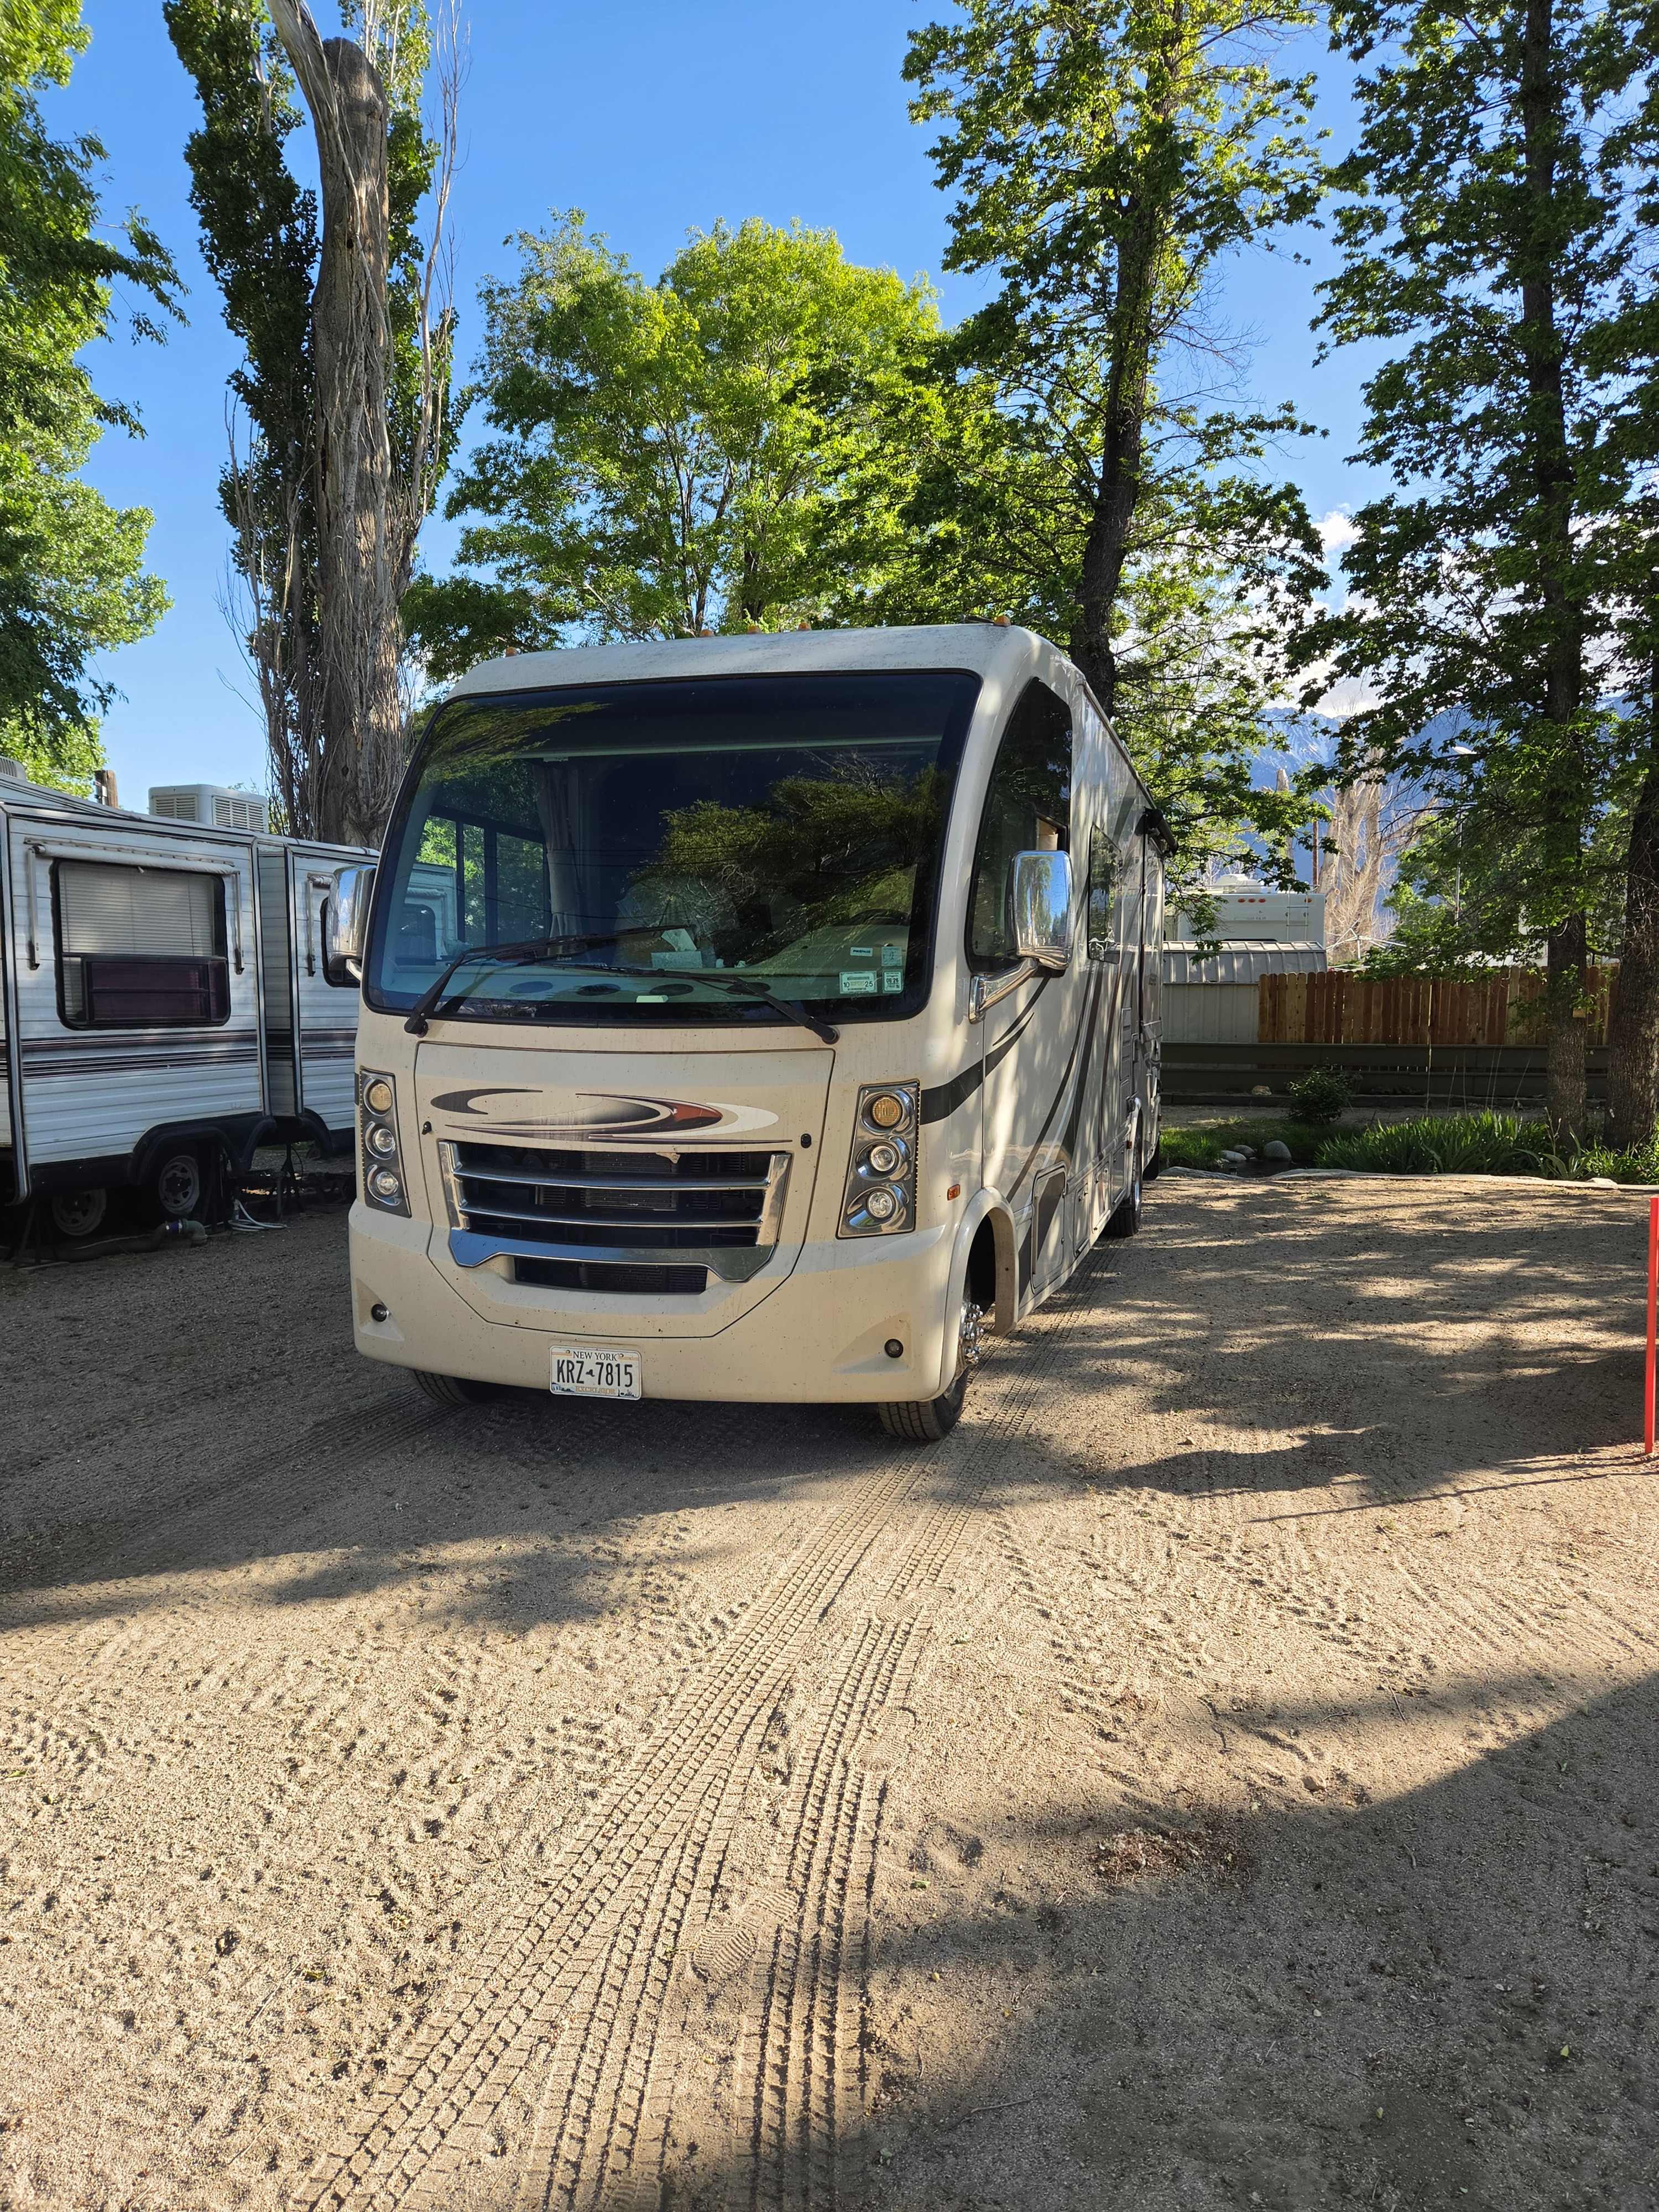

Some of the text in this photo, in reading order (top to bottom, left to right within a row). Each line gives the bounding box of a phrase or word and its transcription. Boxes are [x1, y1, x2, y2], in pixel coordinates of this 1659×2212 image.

[573, 1351, 618, 1361] NEW YORK
[557, 1359, 633, 1387] KRZ 7815
